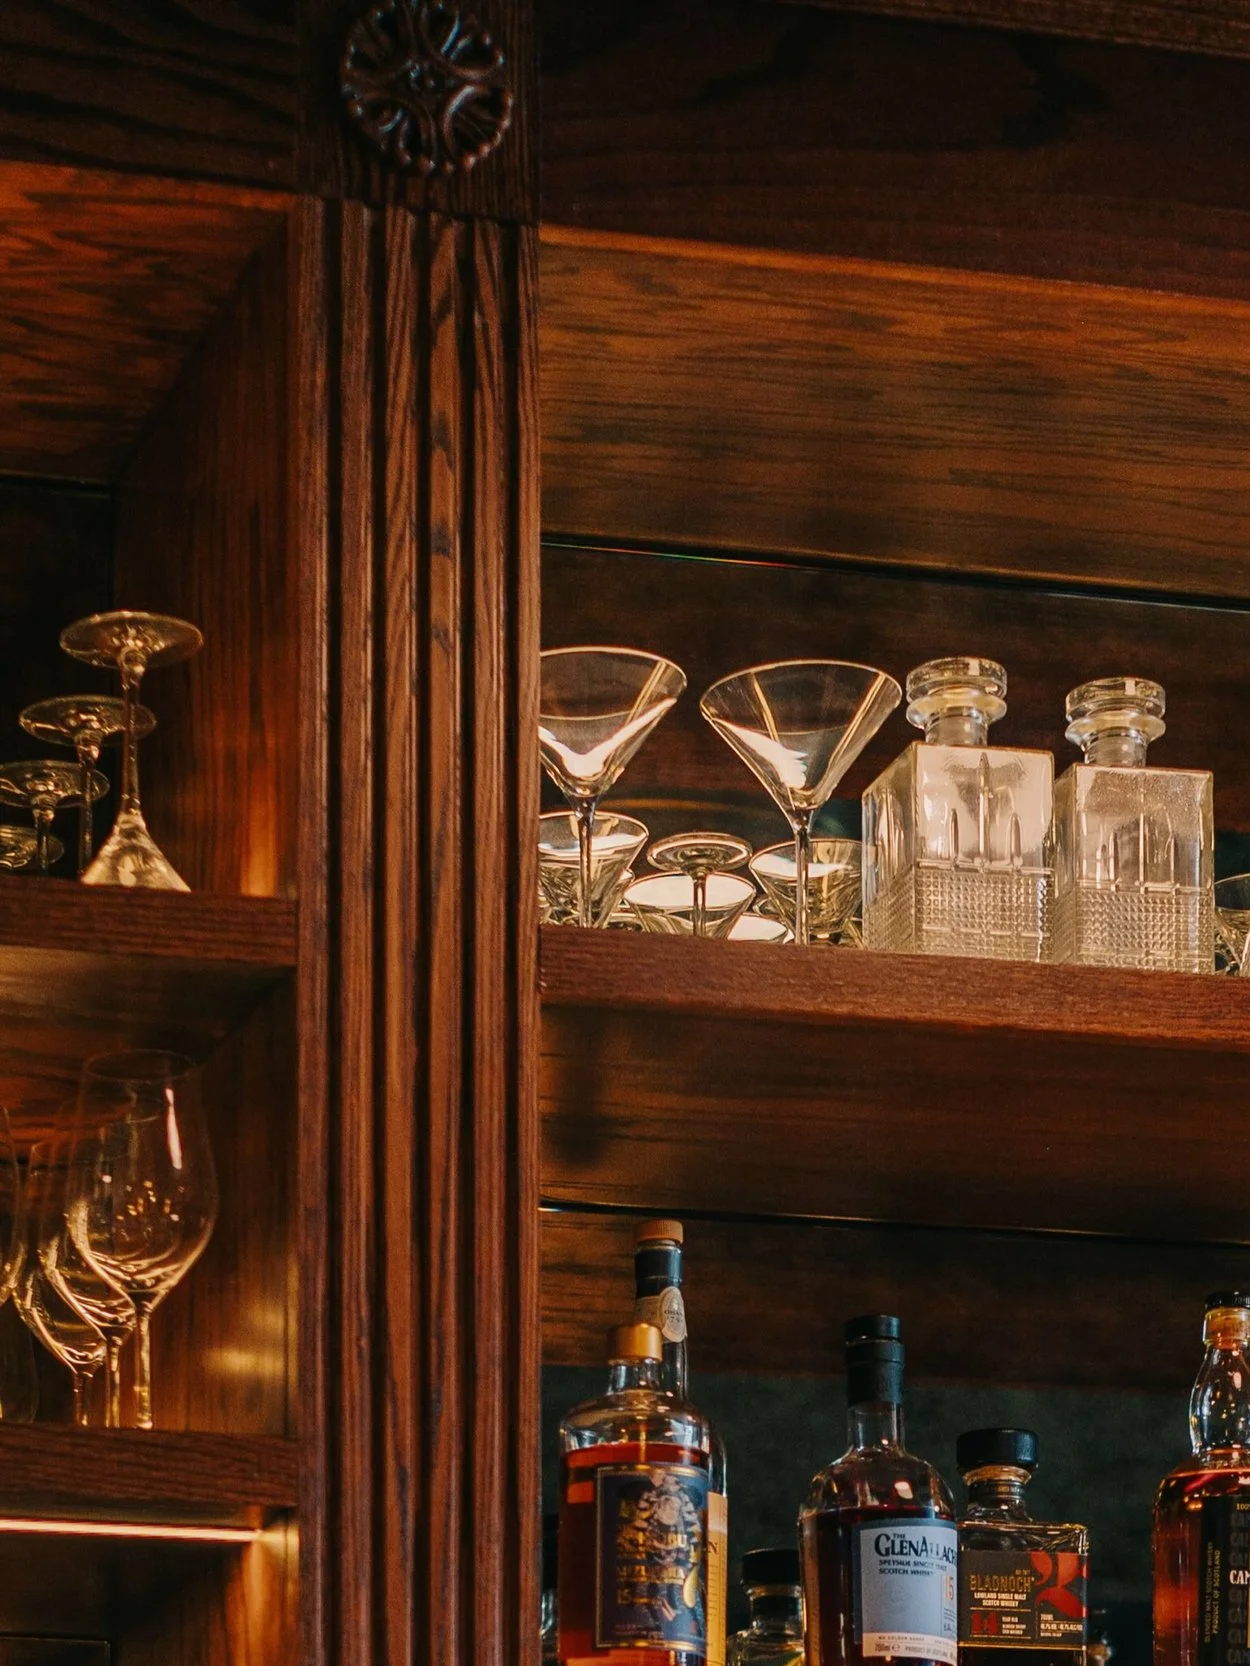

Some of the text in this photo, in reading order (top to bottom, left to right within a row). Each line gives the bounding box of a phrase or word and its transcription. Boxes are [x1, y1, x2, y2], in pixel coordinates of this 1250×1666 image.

[879, 1559, 911, 1567] SPEYSIDE
[970, 1574, 1032, 1592] BLADNOCH
[971, 1611, 998, 1636] 14
